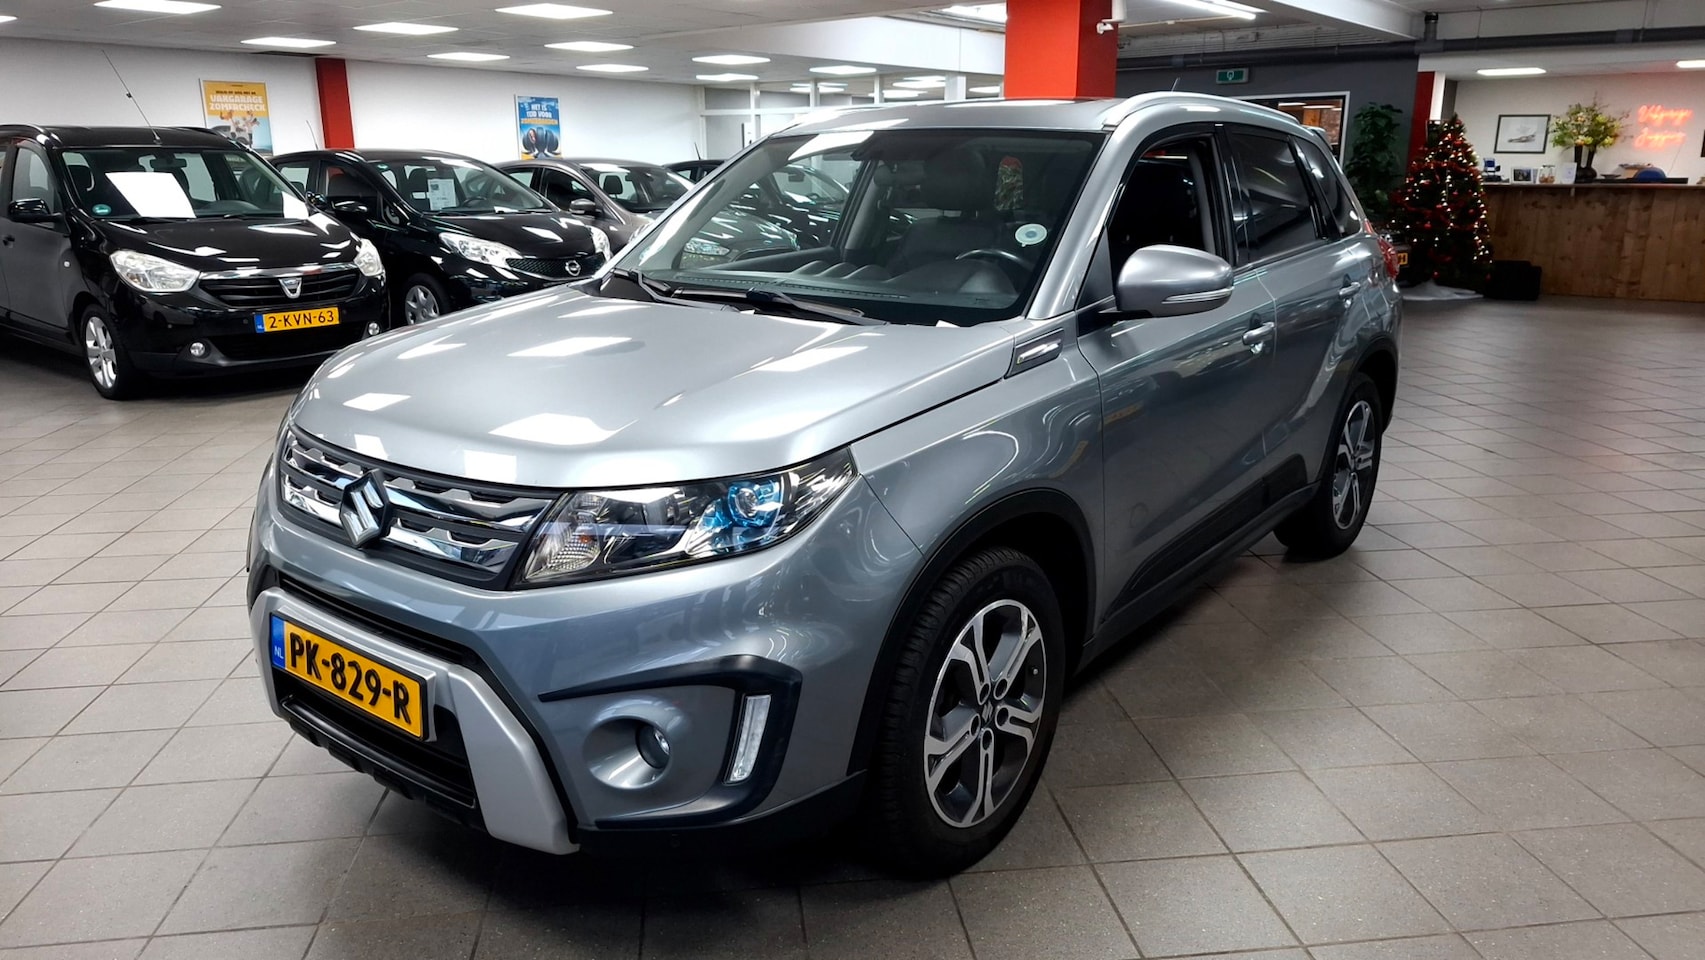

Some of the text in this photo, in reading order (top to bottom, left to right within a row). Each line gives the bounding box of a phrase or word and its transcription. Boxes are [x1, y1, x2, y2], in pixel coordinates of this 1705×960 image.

[268, 310, 335, 329] 2-KVN-63
[273, 632, 412, 725] NL PK-829-R
